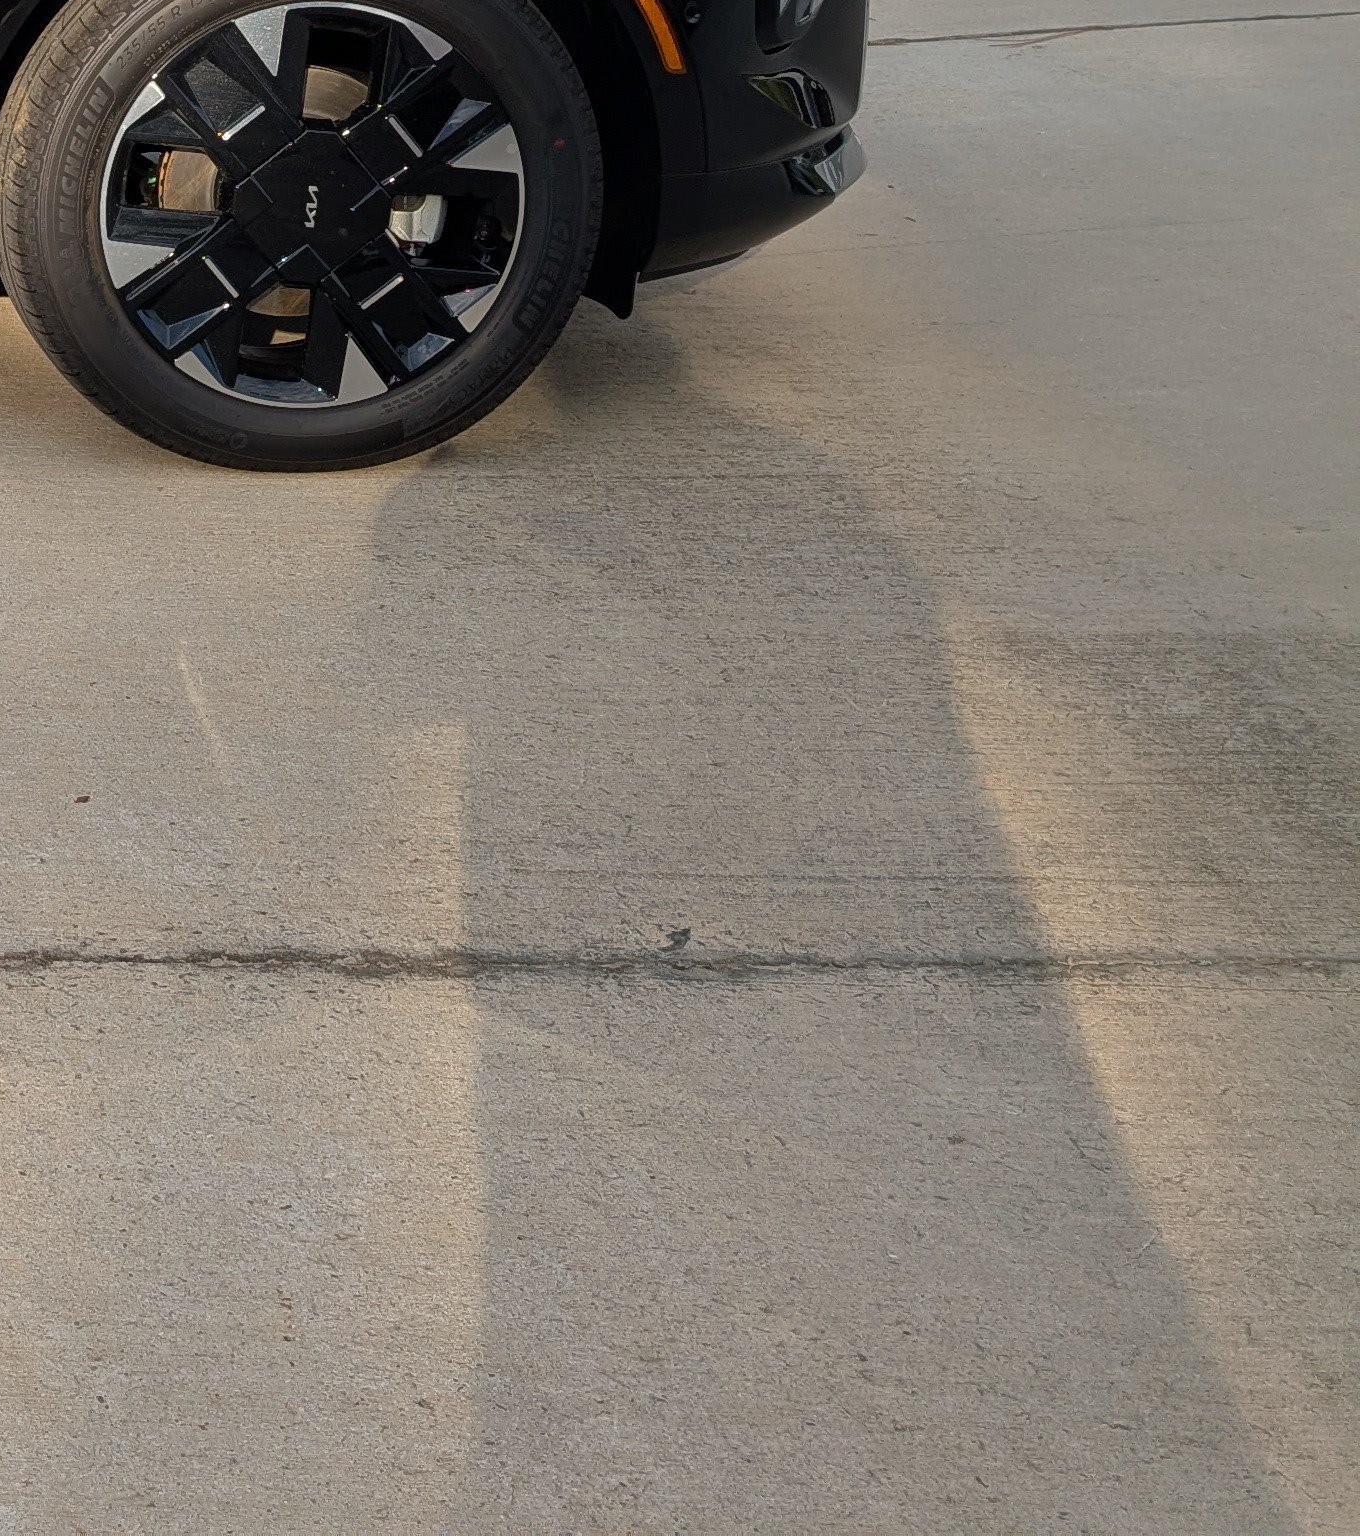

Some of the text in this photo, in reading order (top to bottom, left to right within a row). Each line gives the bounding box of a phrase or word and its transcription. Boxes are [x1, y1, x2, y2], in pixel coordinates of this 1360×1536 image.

[59, 86, 109, 236] MICHELIN
[116, 17, 167, 70] 235/55
[170, 5, 183, 25] R
